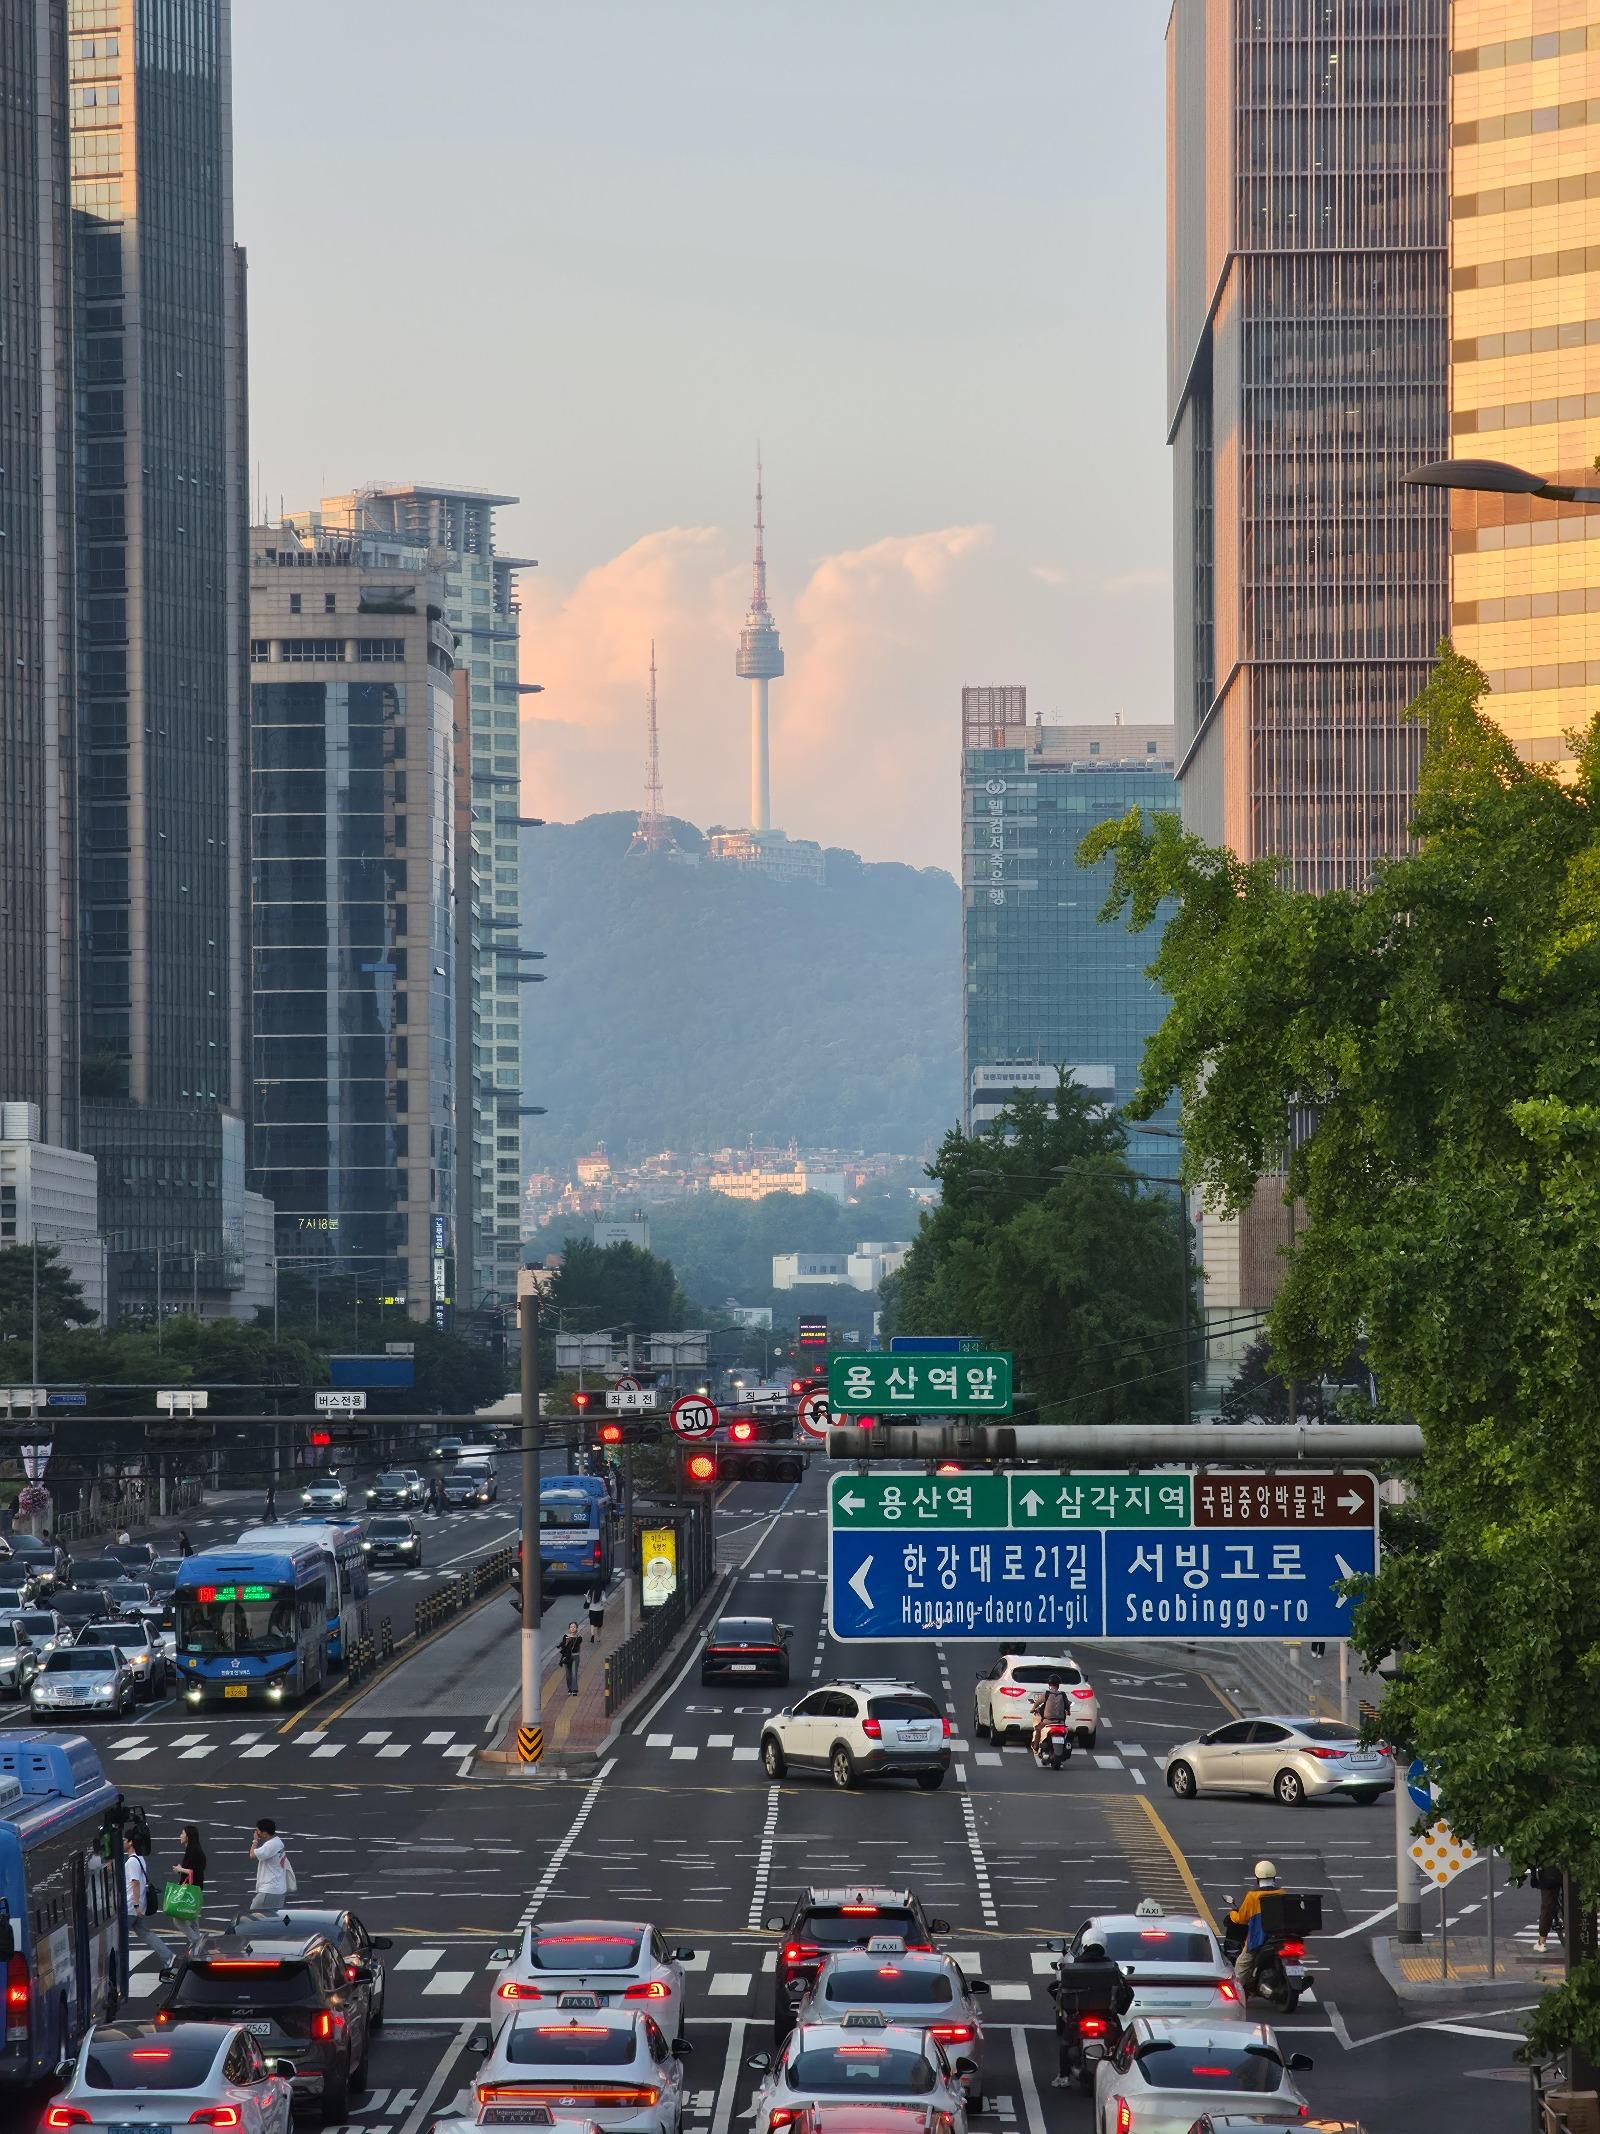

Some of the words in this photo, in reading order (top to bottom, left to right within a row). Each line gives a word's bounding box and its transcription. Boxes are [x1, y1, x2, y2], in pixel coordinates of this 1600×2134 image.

[611, 1392, 653, 1405] 좌회전
[843, 1365, 997, 1400] 용산역앞
[319, 1395, 362, 1407] 버스전용
[682, 1409, 708, 1430] 50
[573, 1513, 587, 1521] 502
[878, 1486, 972, 1520] 용산역
[1055, 1486, 1184, 1519] 삼각지역
[1201, 1485, 1326, 1519] 국립중앙박물관
[902, 1544, 1025, 1590] 한강대로
[1034, 1544, 1087, 1590] 21길
[1127, 1544, 1306, 1590] 서빙고로
[902, 1594, 1032, 1630] Hangang-daero
[1038, 1594, 1088, 1630] 21-gil
[1126, 1593, 1308, 1629] Seobinggo-ro
[1142, 1907, 1159, 1915] TAXI
[565, 1998, 591, 2007] TAXI
[852, 2016, 877, 2025] TAXI
